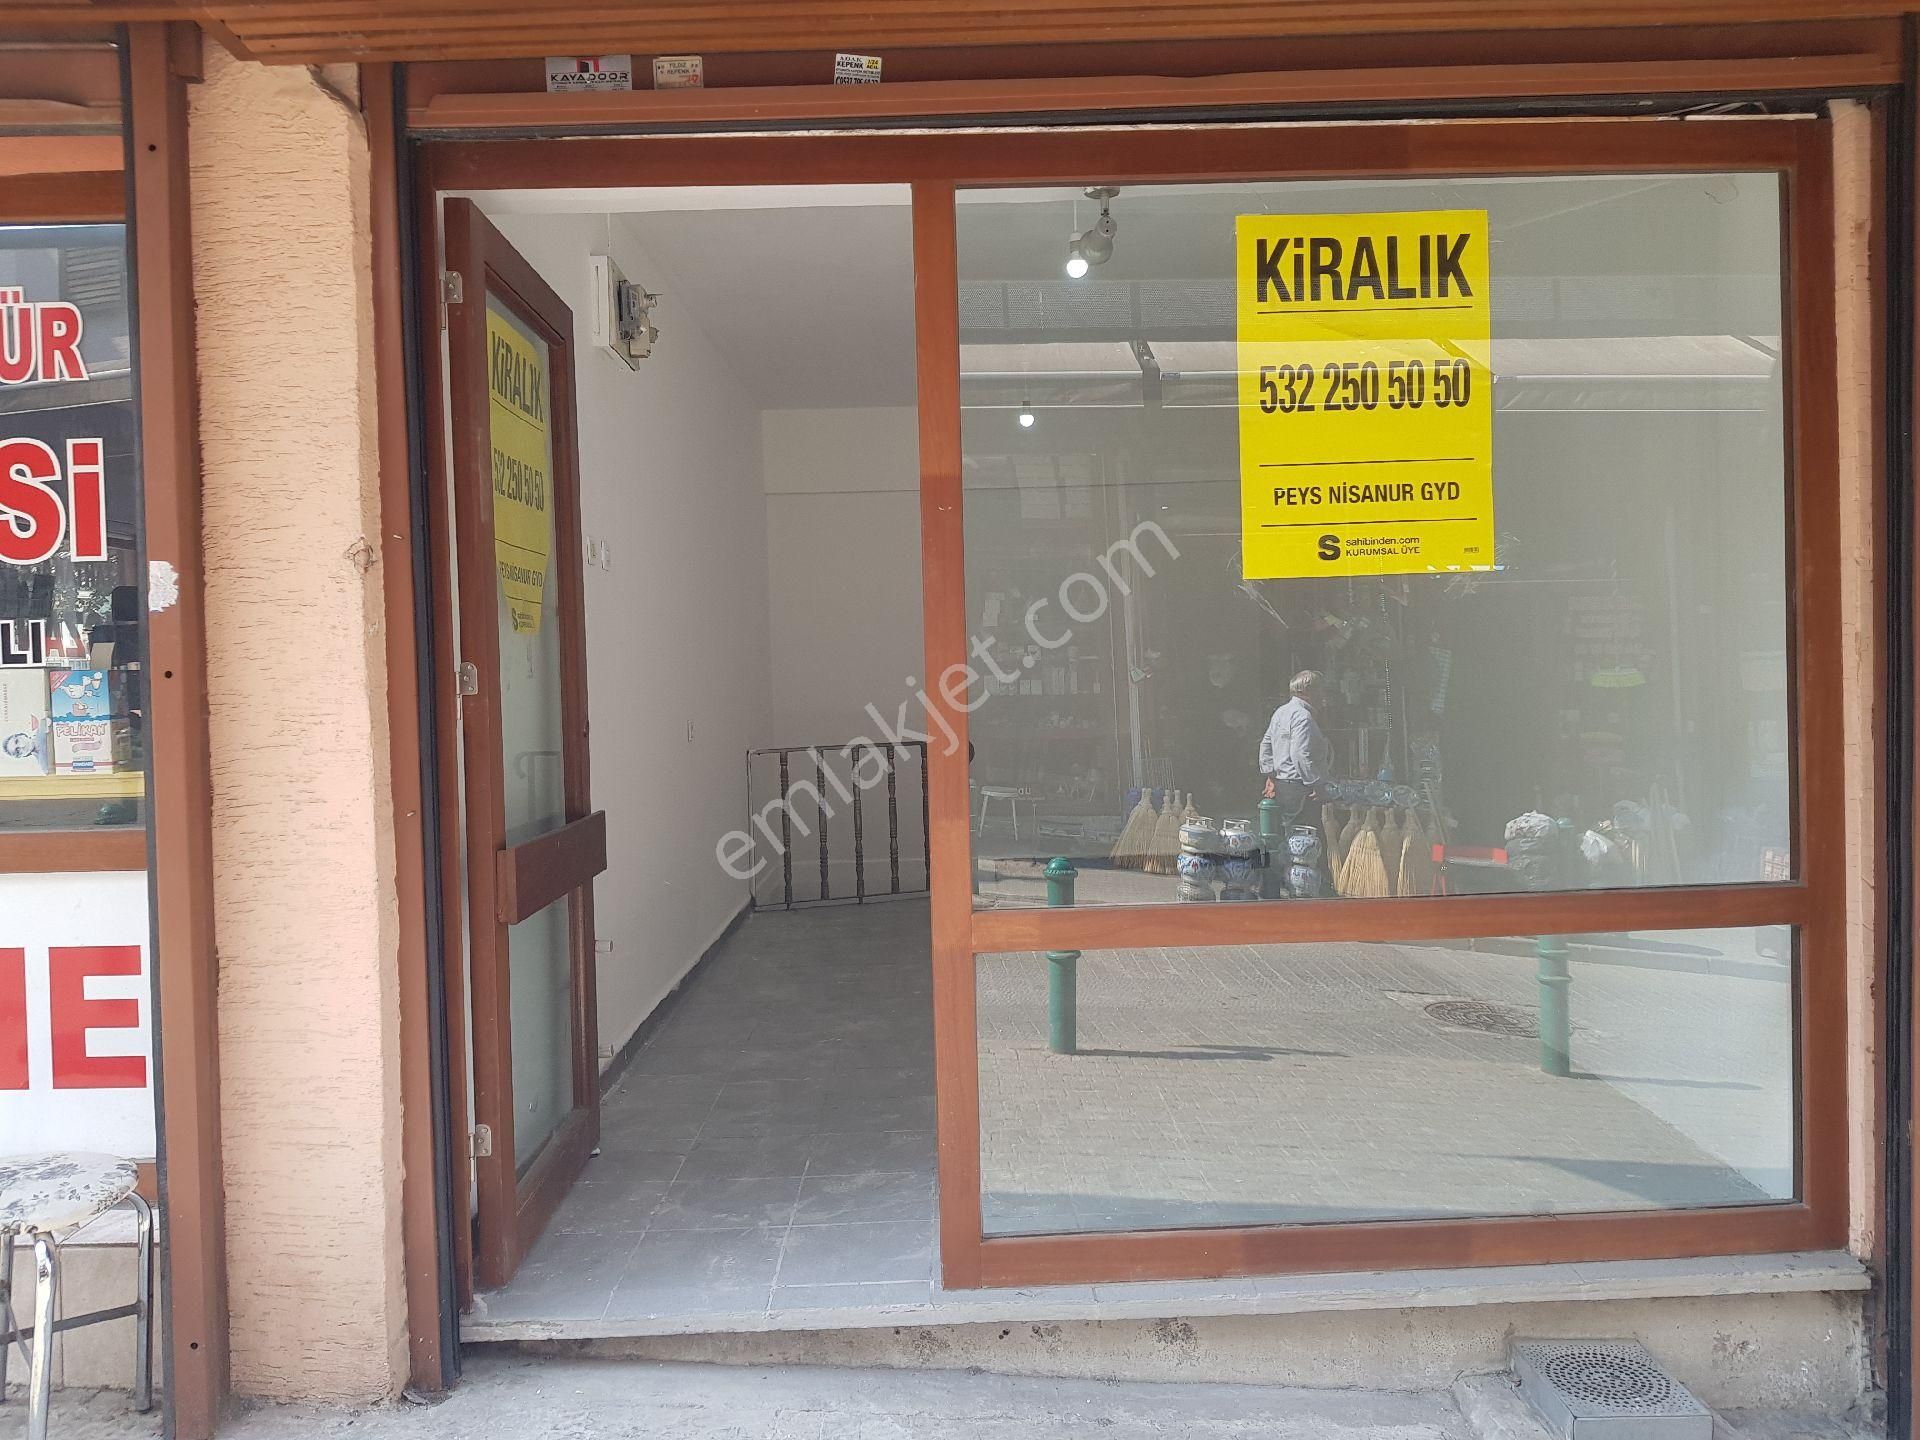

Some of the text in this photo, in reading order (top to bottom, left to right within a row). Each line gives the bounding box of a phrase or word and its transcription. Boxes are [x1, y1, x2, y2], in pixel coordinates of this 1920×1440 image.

[551, 72, 628, 82] KAYADOOR
[0, 286, 90, 385] ÜR
[1260, 358, 1471, 414] 532 250 50 50
[507, 455, 523, 503] 250
[524, 463, 534, 508] 50
[535, 469, 544, 512] 50
[1273, 480, 1460, 506] PEYS NİSANUR GYD
[1345, 536, 1420, 547] sahibinden.com
[1345, 545, 1421, 557] KURUMSAL ÜYE
